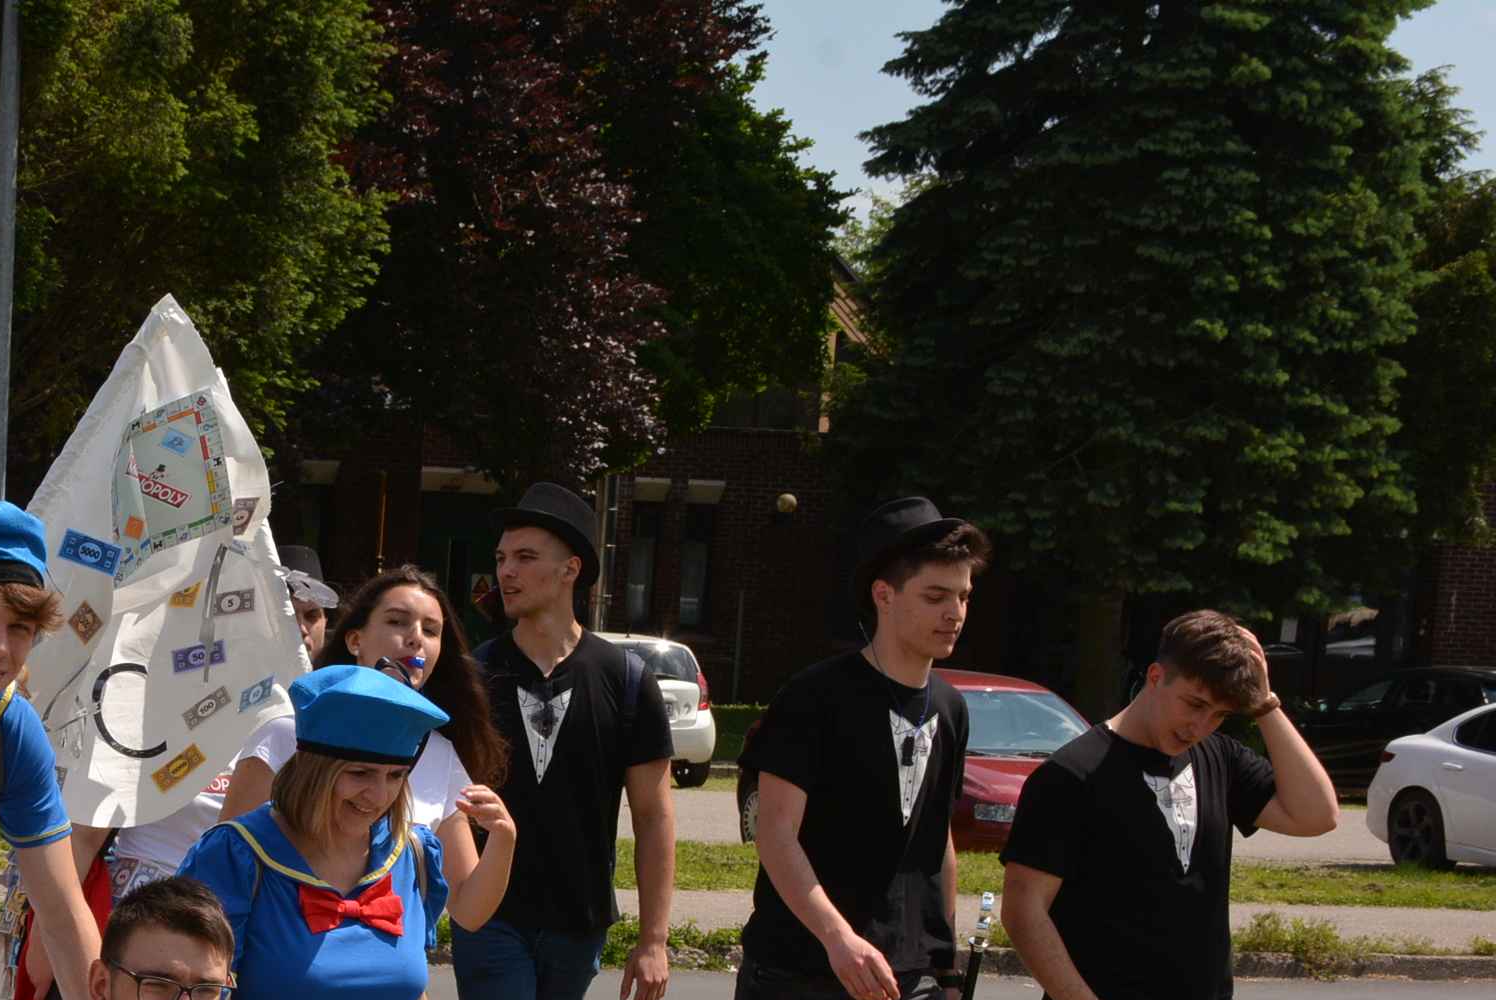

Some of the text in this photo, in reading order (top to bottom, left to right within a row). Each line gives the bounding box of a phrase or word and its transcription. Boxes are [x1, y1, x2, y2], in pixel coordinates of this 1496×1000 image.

[227, 600, 234, 608] 5
[192, 652, 206, 662] 50
[199, 701, 215, 714] 100
[207, 777, 230, 792] OP
